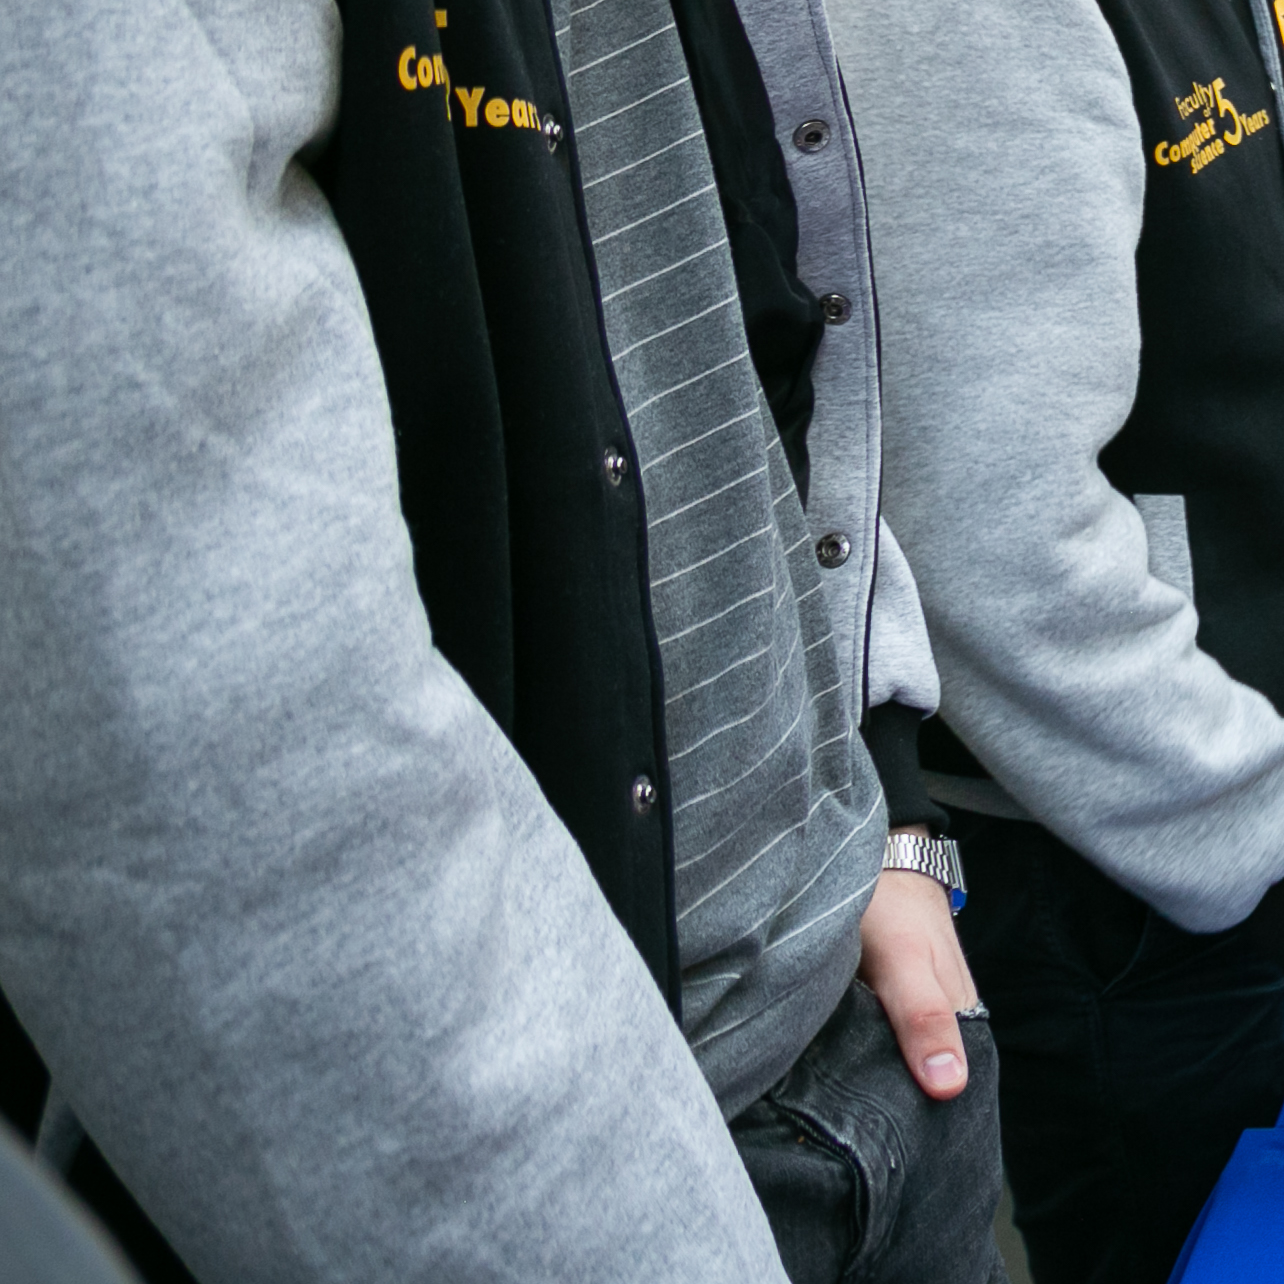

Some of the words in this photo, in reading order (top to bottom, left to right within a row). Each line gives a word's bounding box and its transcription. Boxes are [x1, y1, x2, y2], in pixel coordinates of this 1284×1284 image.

[1175, 81, 1214, 120] Faculty
[1212, 77, 1242, 146] 5
[1238, 109, 1270, 136] Years
[1154, 118, 1216, 166] Computer
